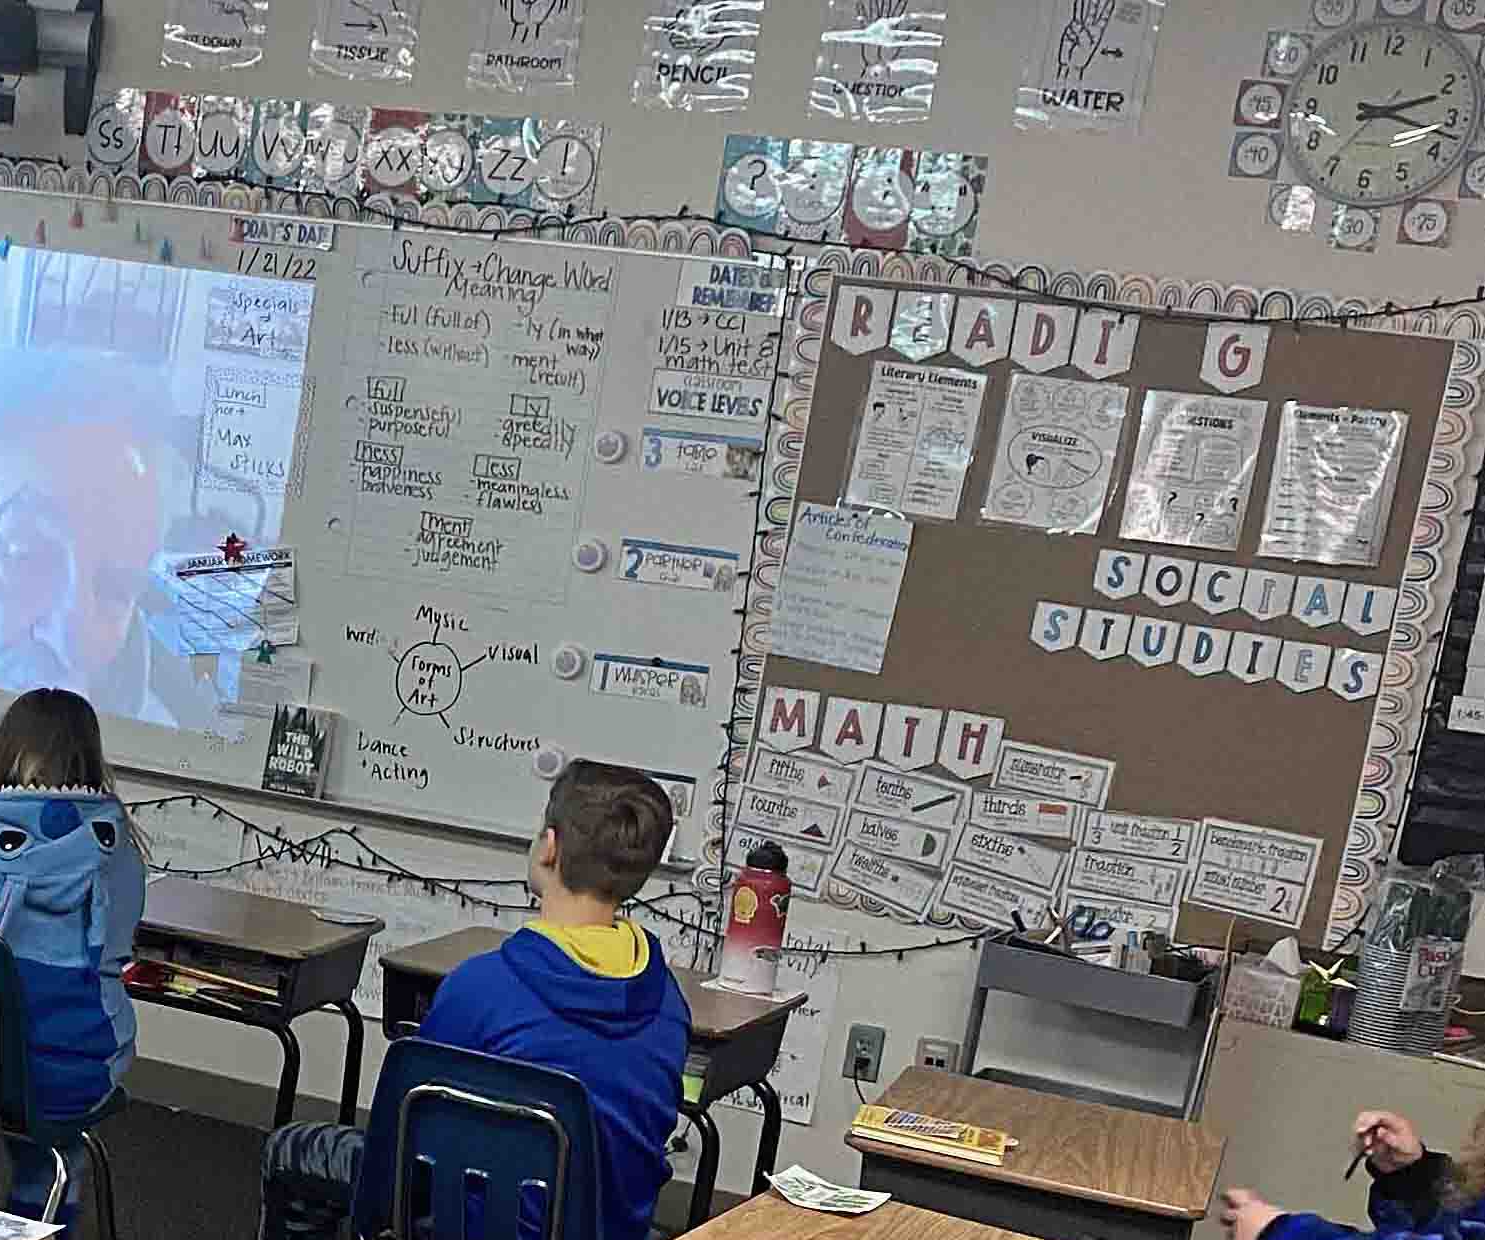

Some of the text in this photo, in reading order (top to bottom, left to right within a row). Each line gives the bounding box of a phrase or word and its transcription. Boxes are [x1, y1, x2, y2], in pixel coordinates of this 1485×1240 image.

[1350, 38, 1367, 63] 11
[1383, 34, 1405, 55] 12
[1424, 48, 1432, 68] 1
[1317, 64, 1340, 85] 10
[1441, 73, 1456, 95] 2
[1042, 88, 1125, 112] WATER
[1445, 108, 1459, 128] 3
[98, 119, 124, 150] Ss
[1306, 131, 1321, 150] 8
[1427, 141, 1441, 162] 4
[1325, 155, 1340, 176] 7
[1395, 162, 1410, 182] 5
[1358, 169, 1373, 189] 6
[235, 248, 317, 282] 1/21/22
[476, 479, 570, 501] meaningless
[1106, 554, 1376, 626] SOCIAL
[415, 604, 469, 631] Music
[1044, 608, 1370, 695] STUDIES
[411, 655, 453, 678] Forms
[418, 675, 434, 690] of
[406, 688, 439, 707] Art
[283, 730, 311, 745] THE
[453, 725, 541, 752] Structures
[769, 696, 990, 766] MATH
[276, 741, 314, 761] WILD
[267, 754, 315, 776] ROBOT
[371, 762, 430, 789] Acting
